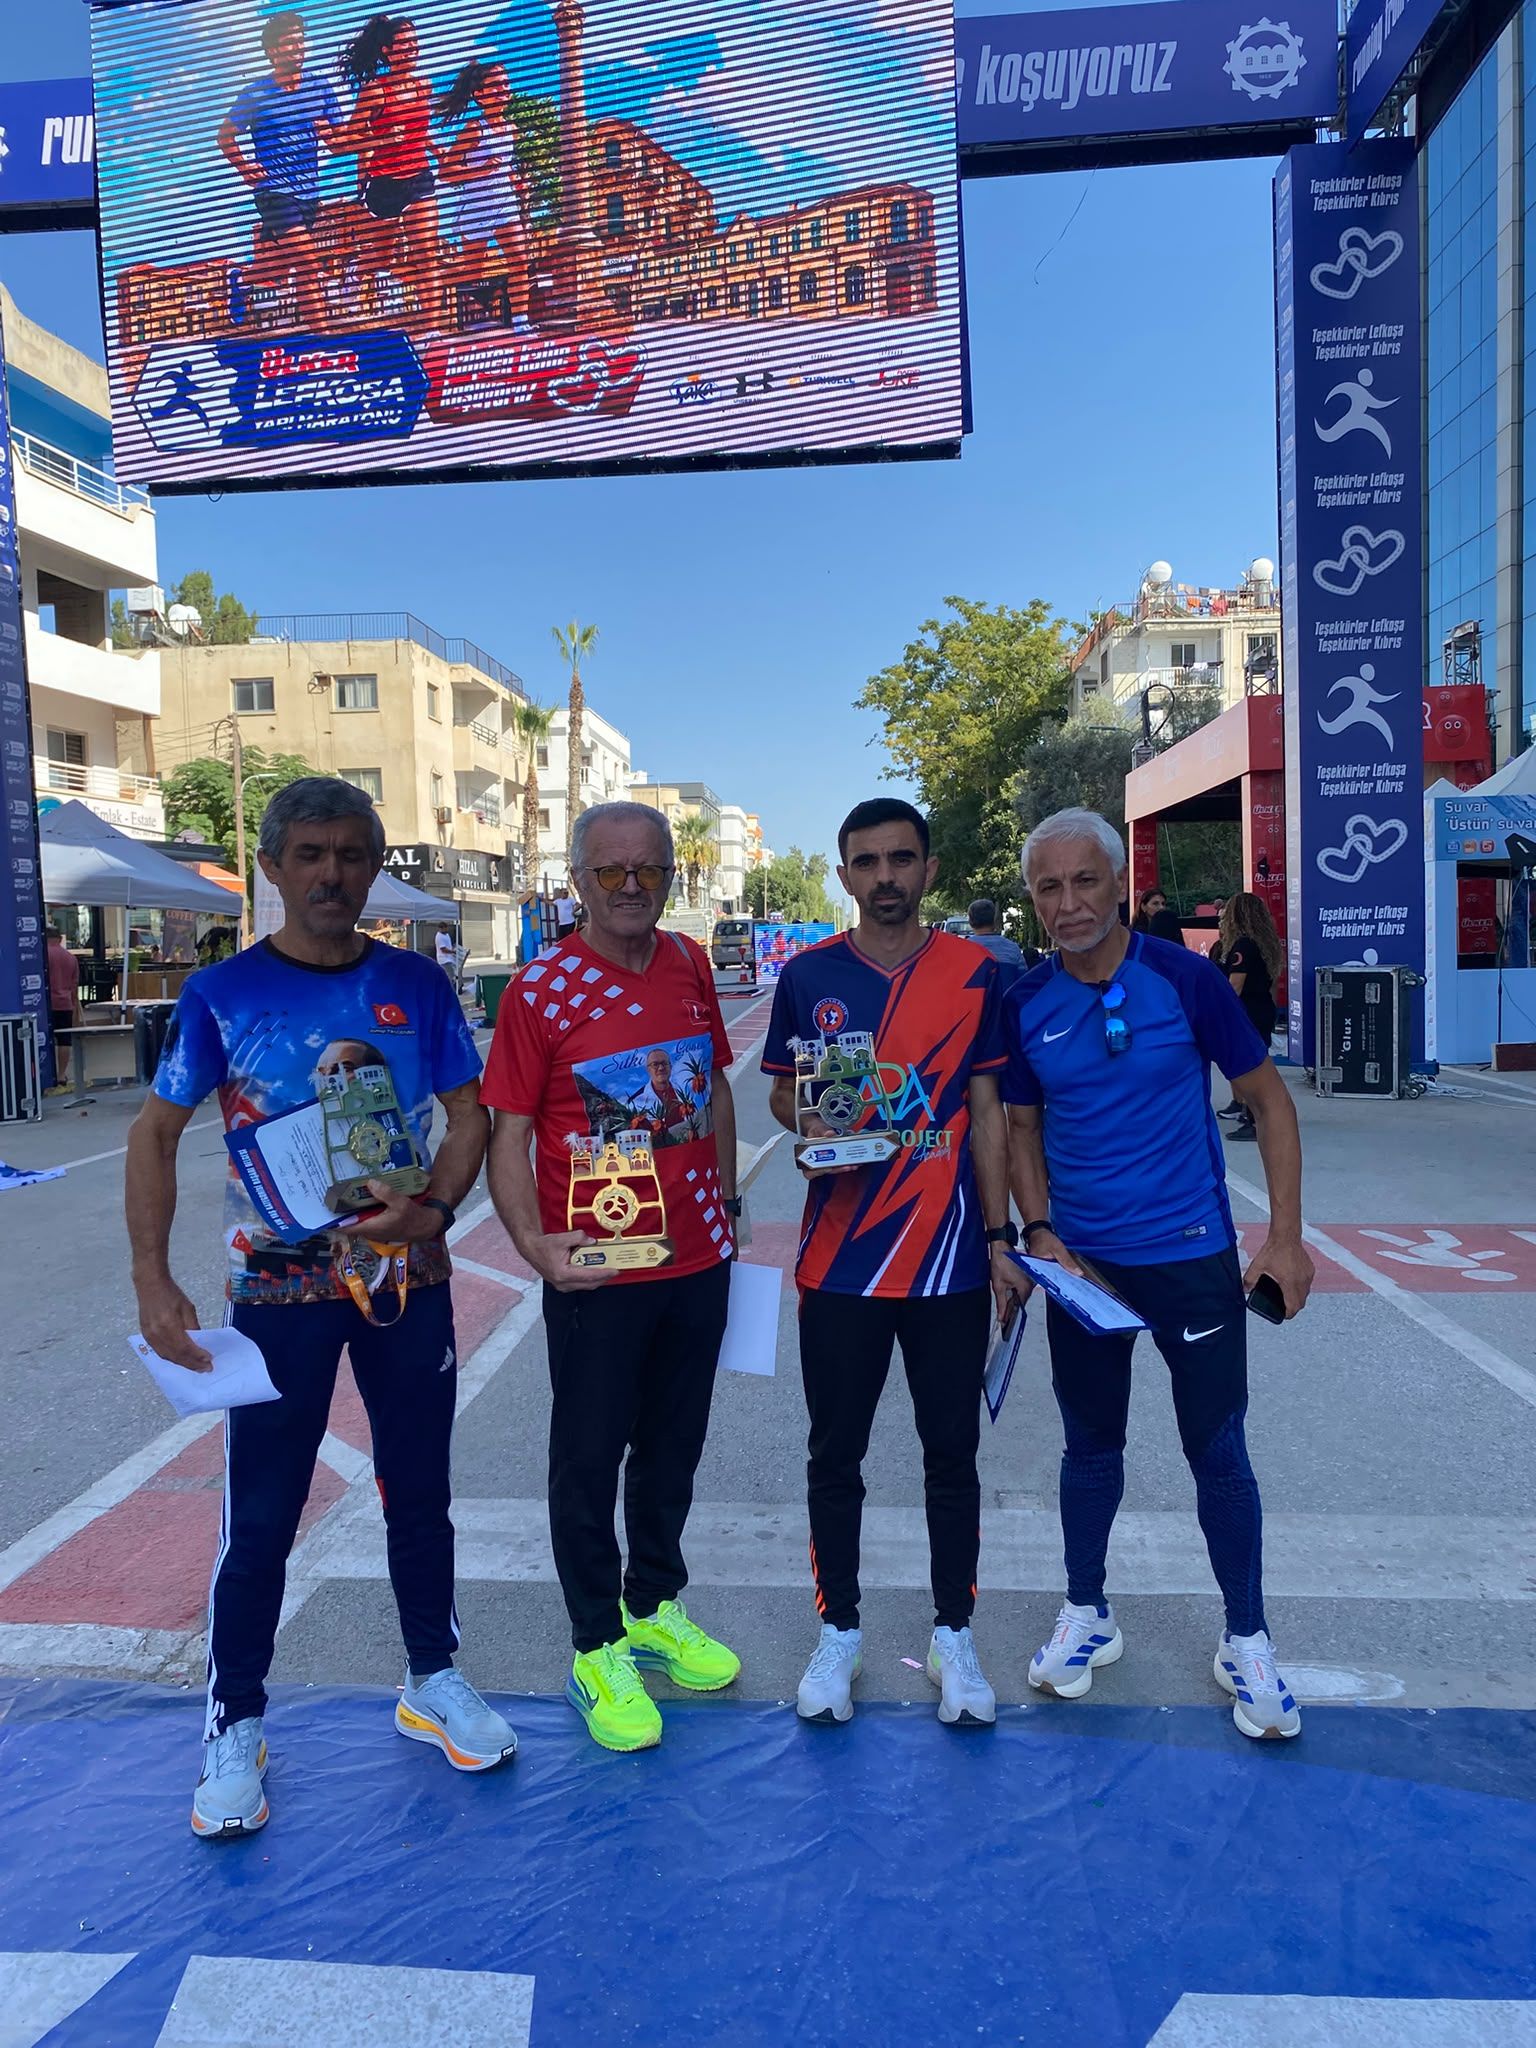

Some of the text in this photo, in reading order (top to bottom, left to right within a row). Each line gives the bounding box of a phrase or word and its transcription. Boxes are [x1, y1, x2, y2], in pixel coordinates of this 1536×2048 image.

[975, 40, 1178, 113] koşuyoruz
[1310, 177, 1365, 195] Teşekkürler
[1366, 174, 1403, 190] Lefkoşa
[1313, 191, 1400, 213] Teşekkürler Kıbrıs
[1312, 323, 1404, 344] Teşekkürler Lefkoşa
[1315, 340, 1401, 361] Teşekkürler Kıbrıs
[258, 347, 360, 378] ÜLKER
[253, 377, 406, 410] LEFKOŞA
[1313, 471, 1405, 492] Teşekkürler Lefkoşa
[1316, 489, 1402, 509] Teşekkürler Kıbrıs
[1315, 617, 1405, 637] Teşekkürler Lefkoşa
[1318, 635, 1403, 654] Teşekkürler Kıbrıs
[1316, 762, 1407, 781] Teşekkürler Lefkoşa
[1320, 779, 1404, 798] Teşekkürler Kıbrıs
[1444, 801, 1489, 814] Su var
[131, 811, 158, 829] Estate
[1497, 819, 1514, 830] su
[165, 909, 196, 921] COFFEE
[1318, 905, 1408, 923] Teşekkürler Lefkoşa
[1321, 921, 1406, 940] Teşekkürler Kıbrıs
[1342, 1017, 1352, 1051] Glux
